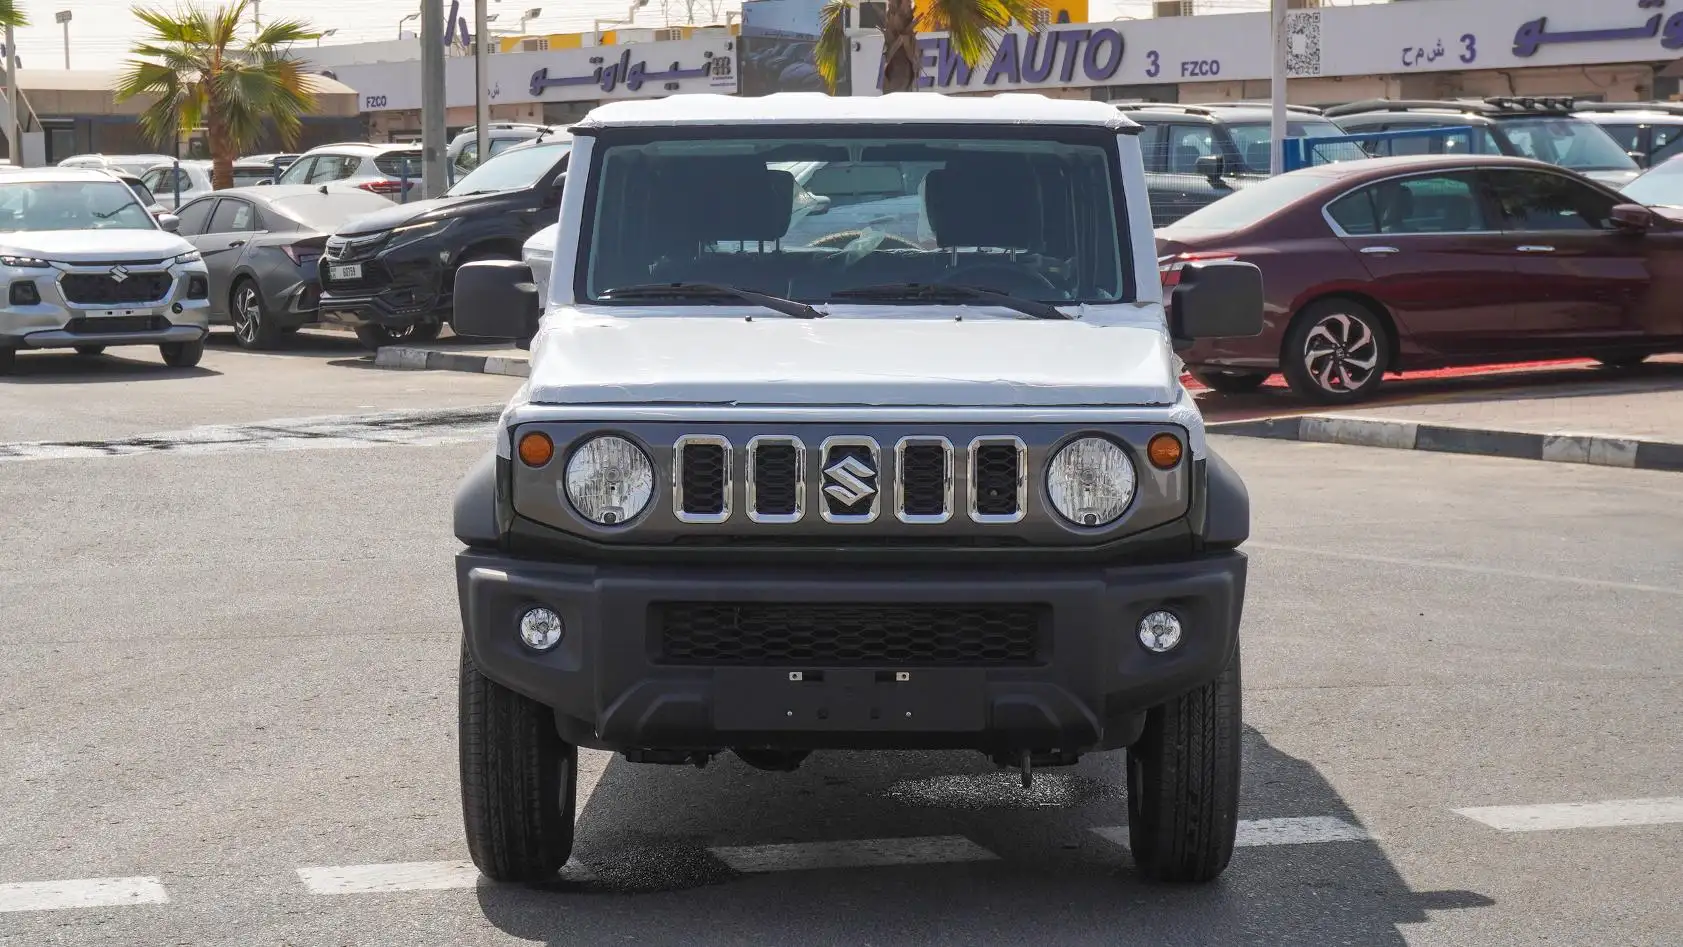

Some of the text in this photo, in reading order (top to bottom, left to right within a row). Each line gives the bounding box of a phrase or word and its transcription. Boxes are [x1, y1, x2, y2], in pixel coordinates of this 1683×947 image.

[876, 27, 1221, 89] EW AUTO 3 FZCO
[1460, 33, 1477, 64] 3
[366, 95, 387, 108] FZCO
